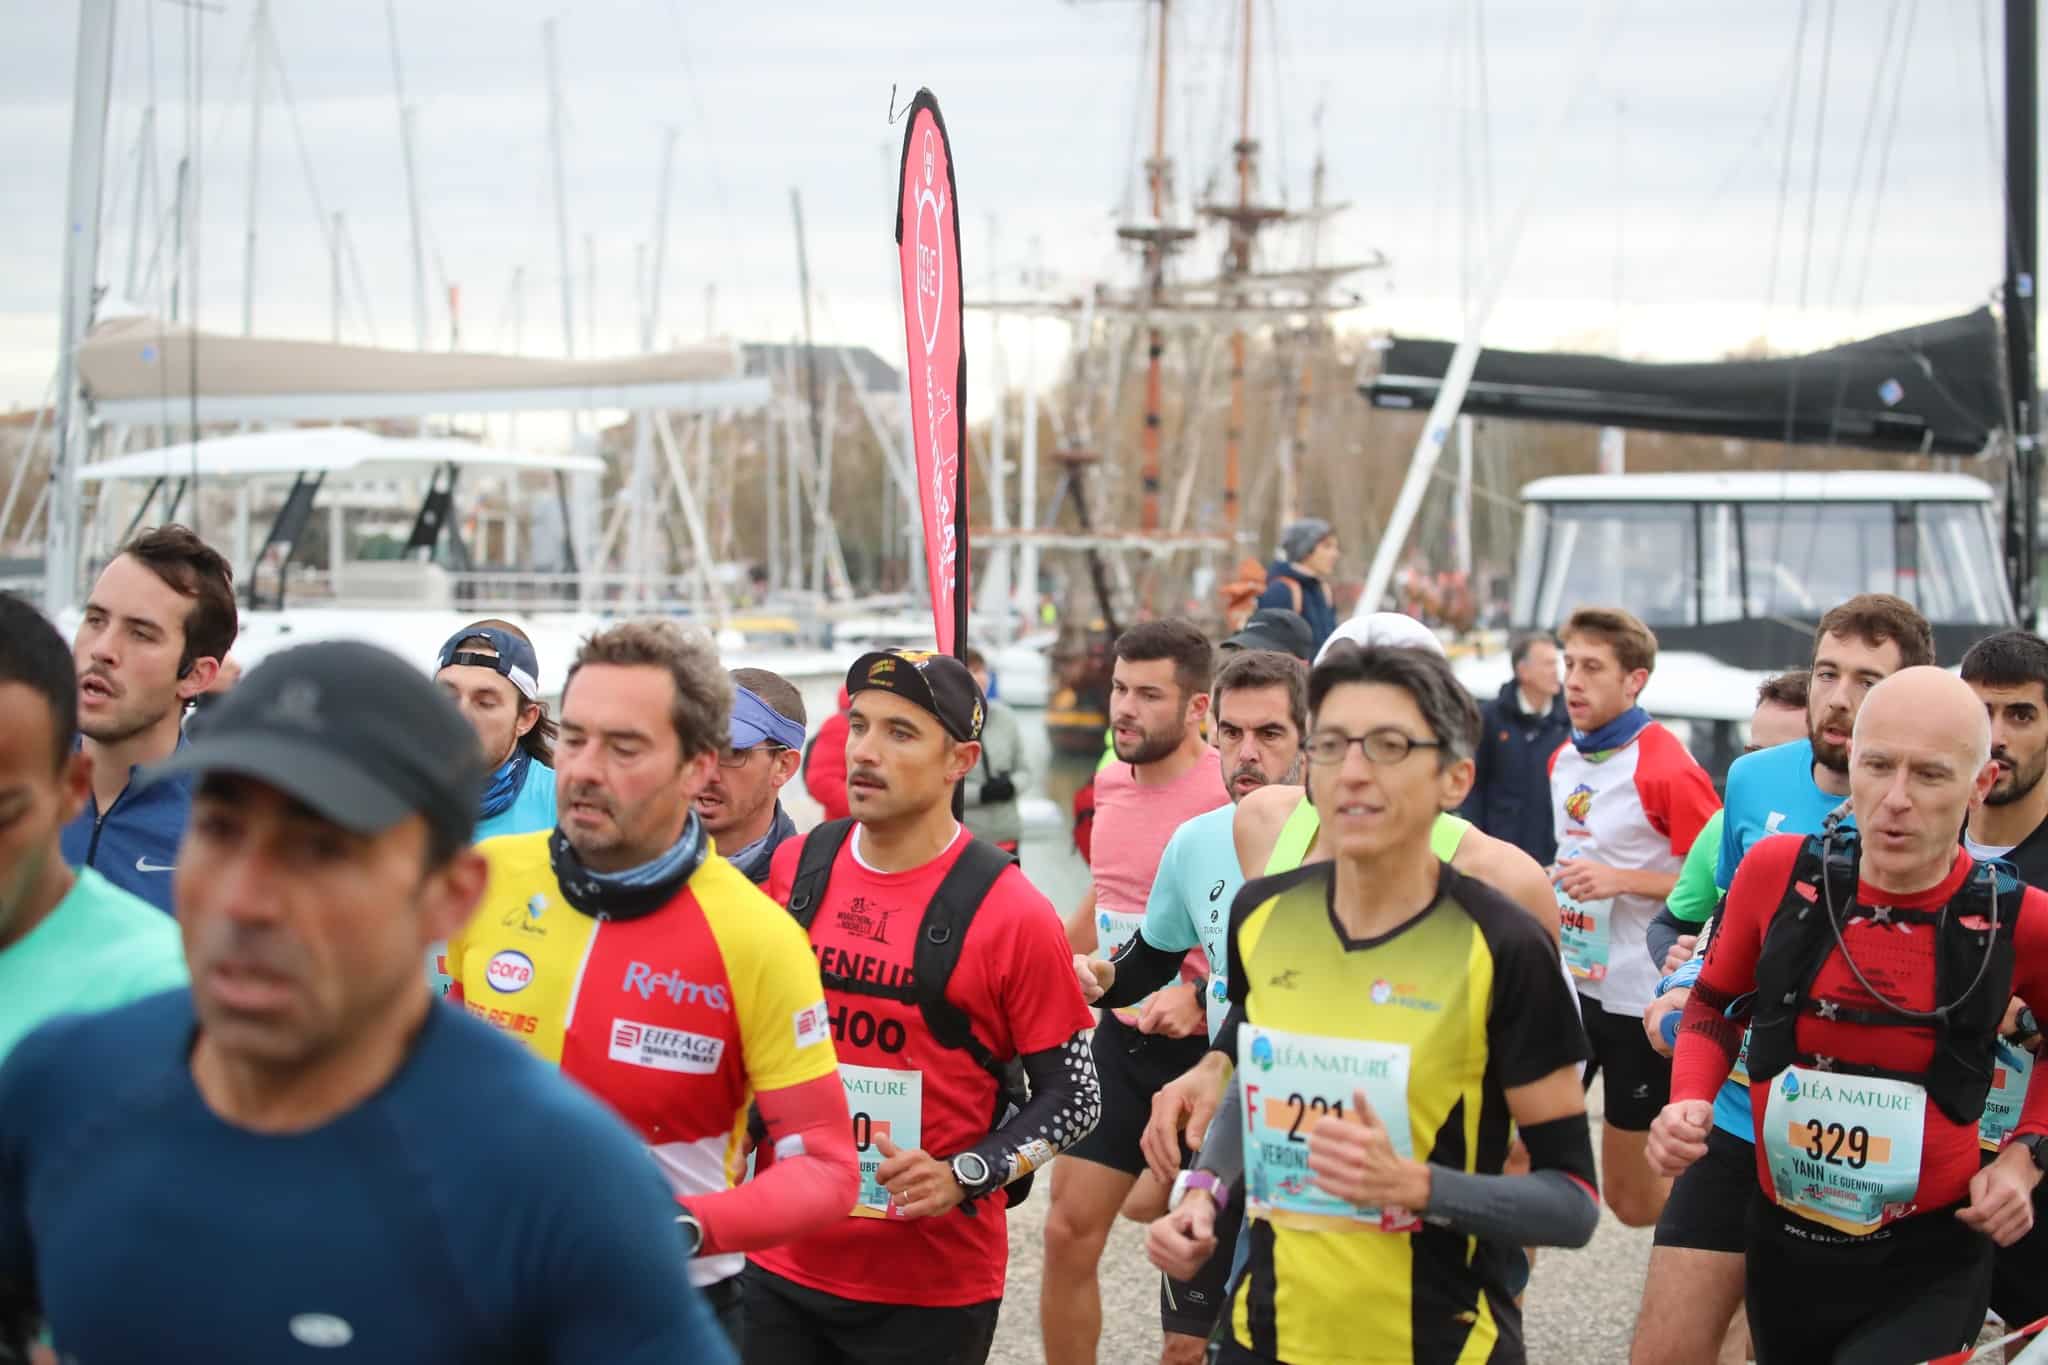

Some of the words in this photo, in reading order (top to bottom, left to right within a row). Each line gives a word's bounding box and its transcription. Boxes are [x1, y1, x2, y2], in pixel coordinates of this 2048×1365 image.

[489, 959, 530, 982] cora
[622, 960, 727, 1010] Reims
[644, 1029, 719, 1055] EIFFAGE
[1276, 1042, 1307, 1069] LÉA
[1312, 1055, 1390, 1079] NATURE
[842, 1078, 909, 1096] NATURE
[1802, 1080, 1832, 1101] LÉA
[1835, 1090, 1913, 1111] NATURE
[1246, 1084, 1259, 1133] F
[1806, 1118, 1869, 1169] 329
[1792, 1157, 1825, 1182] YANN
[1829, 1174, 1839, 1186] LE
[1840, 1177, 1883, 1193] GUENNIOU
